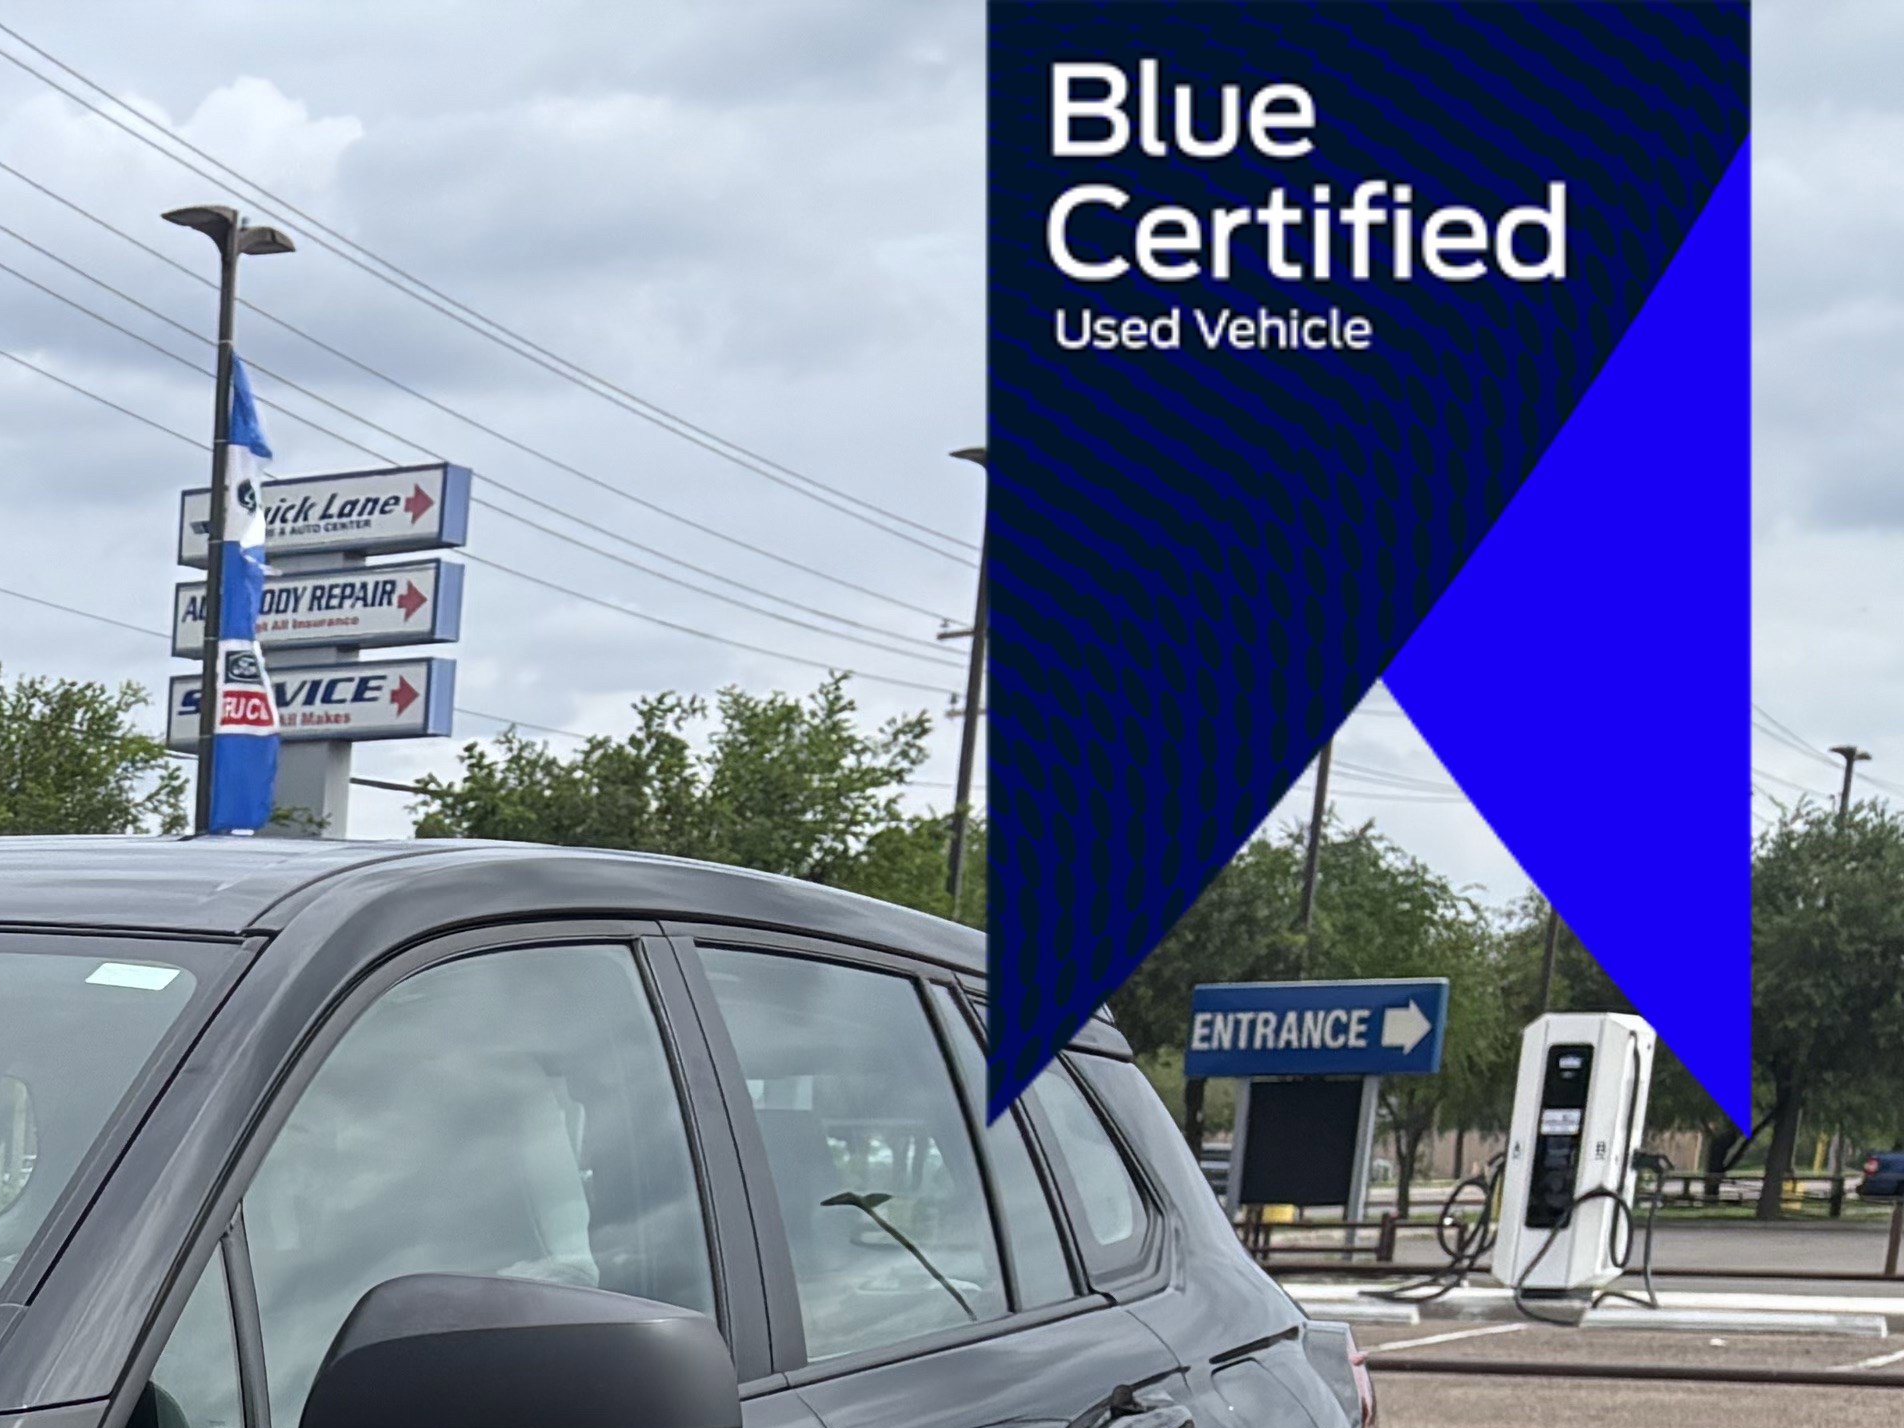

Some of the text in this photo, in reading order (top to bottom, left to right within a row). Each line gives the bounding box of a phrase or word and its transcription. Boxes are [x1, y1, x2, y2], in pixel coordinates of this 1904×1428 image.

[319, 492, 401, 521] Lane
[323, 519, 371, 532] CENTER
[258, 586, 308, 615] ODY
[307, 579, 396, 612] REPAIR
[1192, 1007, 1372, 1052] ENTRANCE
